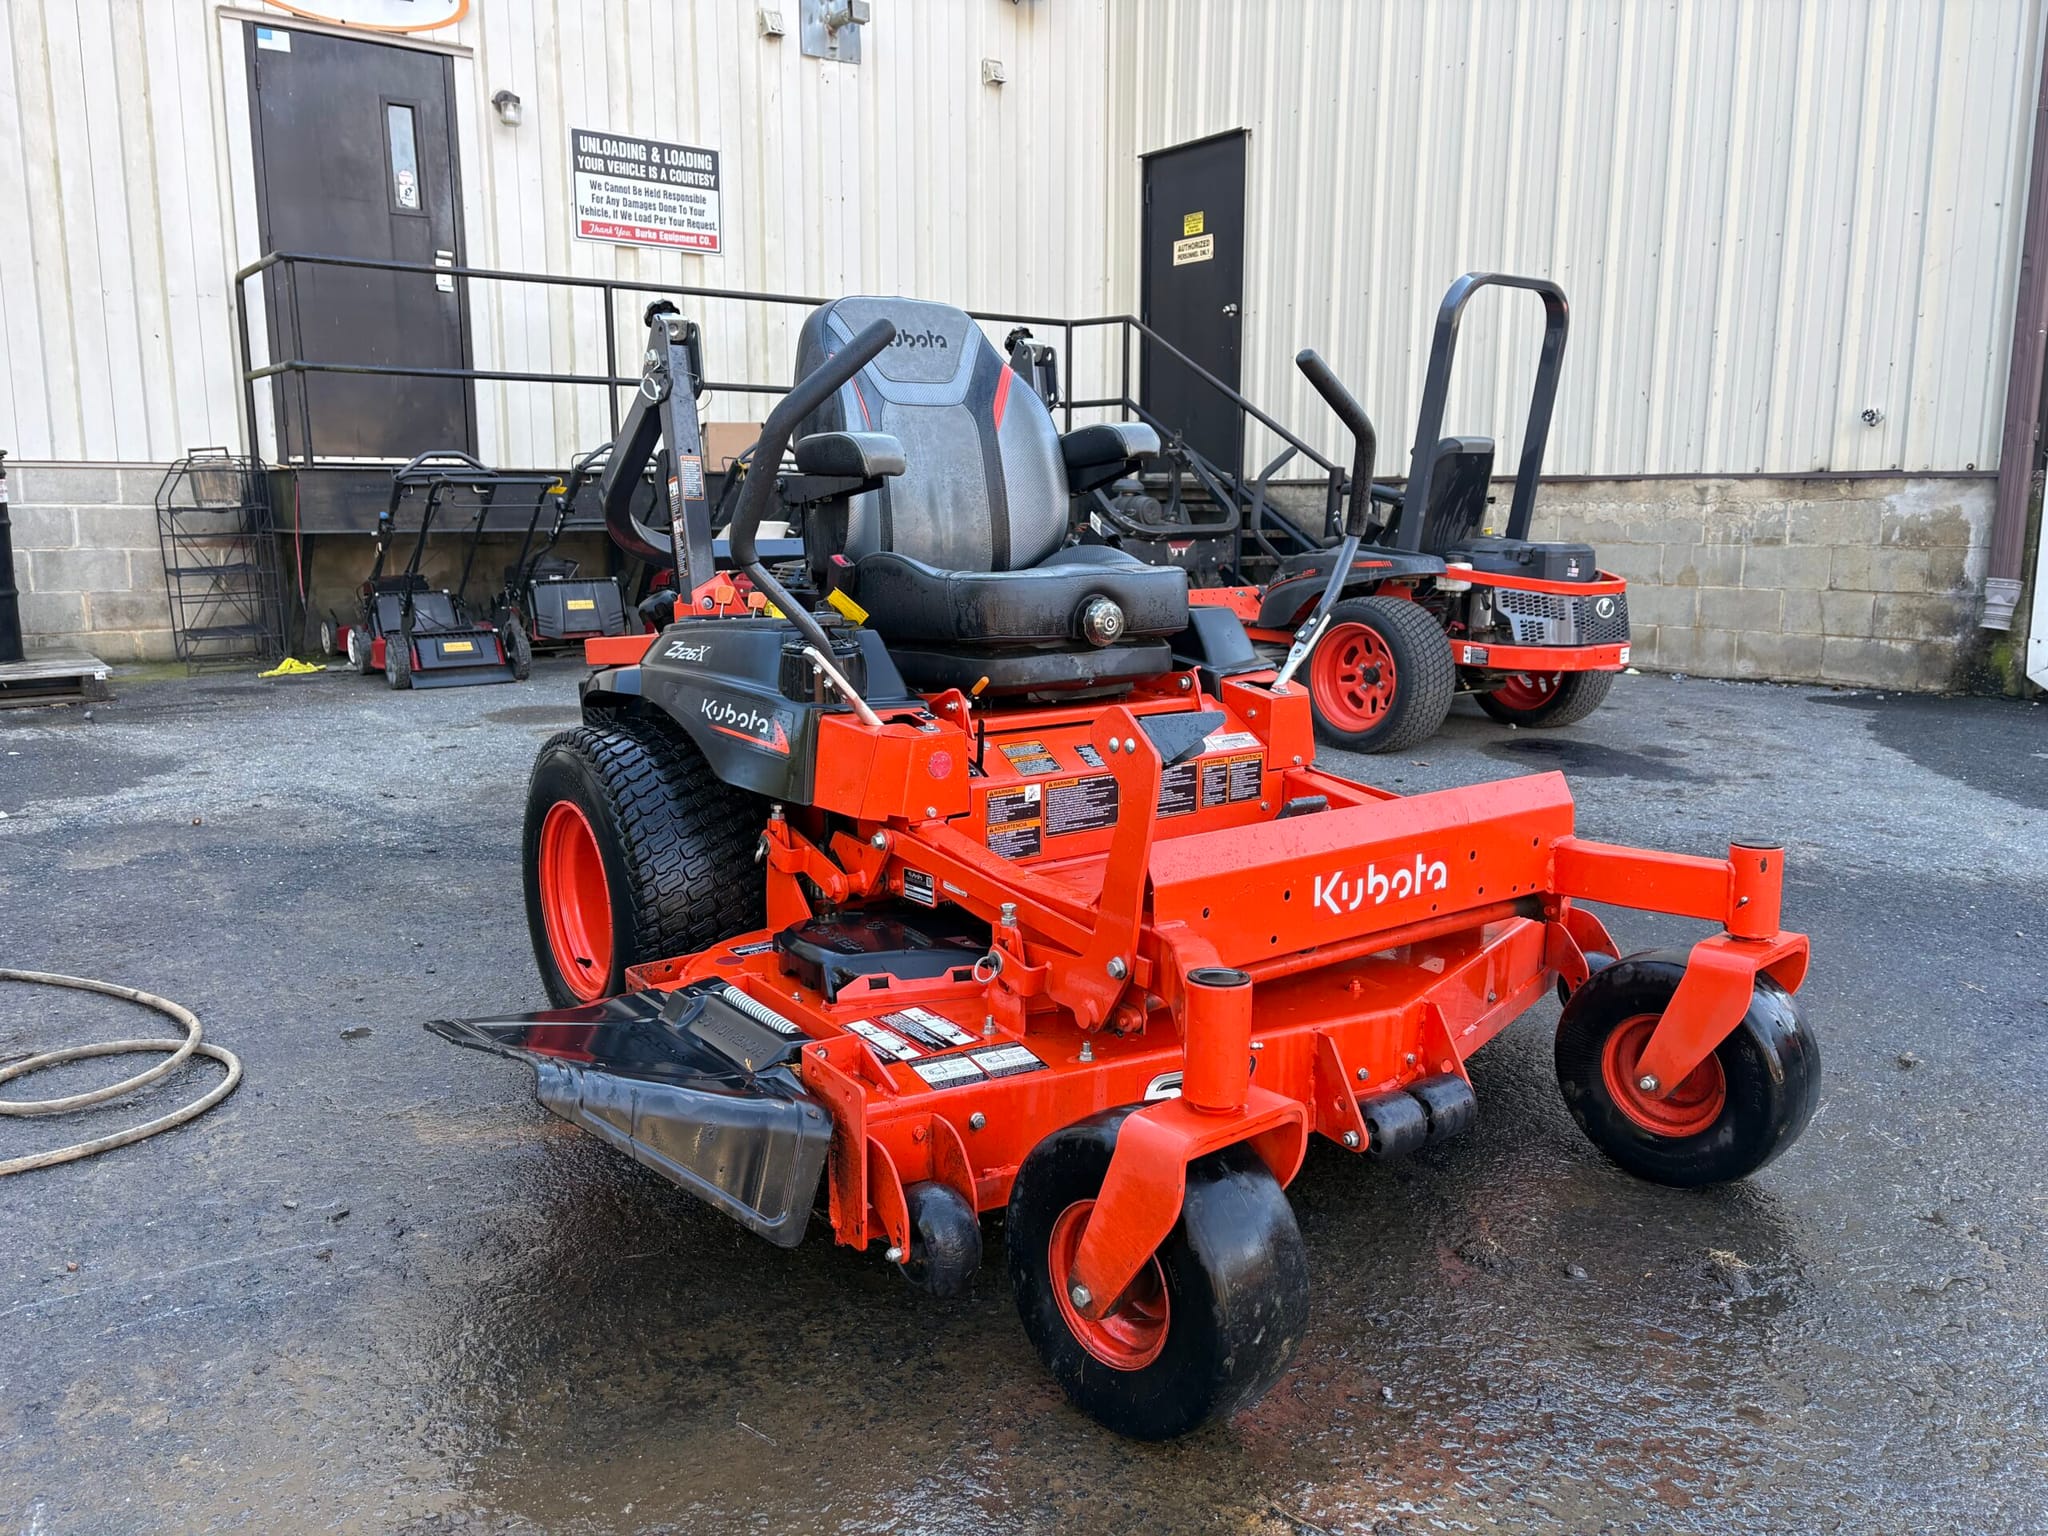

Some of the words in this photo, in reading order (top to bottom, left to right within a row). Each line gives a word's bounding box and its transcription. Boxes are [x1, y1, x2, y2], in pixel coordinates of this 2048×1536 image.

[580, 136, 646, 161] UNLOADING
[651, 147, 660, 163] &
[665, 149, 712, 170] LOADING
[577, 156, 604, 171] YOUR
[607, 160, 645, 177] VEHICLE
[649, 166, 657, 179] IS
[660, 168, 667, 180] A
[670, 170, 715, 187] COURTESY
[590, 180, 602, 190] We
[604, 181, 630, 194] Cannot
[633, 186, 642, 195] Be
[645, 187, 660, 198] Held
[663, 190, 706, 204] Responsible
[592, 194, 603, 204] For
[606, 196, 619, 207] Any
[623, 197, 656, 212] Damages
[659, 203, 677, 213] Done
[680, 205, 687, 214] To
[690, 206, 705, 217] Your
[613, 210, 618, 219] If
[620, 211, 632, 221] We
[634, 213, 652, 223] Load
[654, 215, 666, 225] Per
[669, 217, 685, 227] Your
[687, 219, 717, 230] Request.
[588, 224, 614, 234] Thank
[635, 229, 656, 239] Burke
[659, 232, 696, 244] Equipment
[1178, 239, 1210, 252] AUTHORIZED
[888, 329, 947, 348] ubota
[664, 641, 712, 662] Z726X
[702, 698, 768, 734] Kubota
[1314, 853, 1447, 914] Kubota
